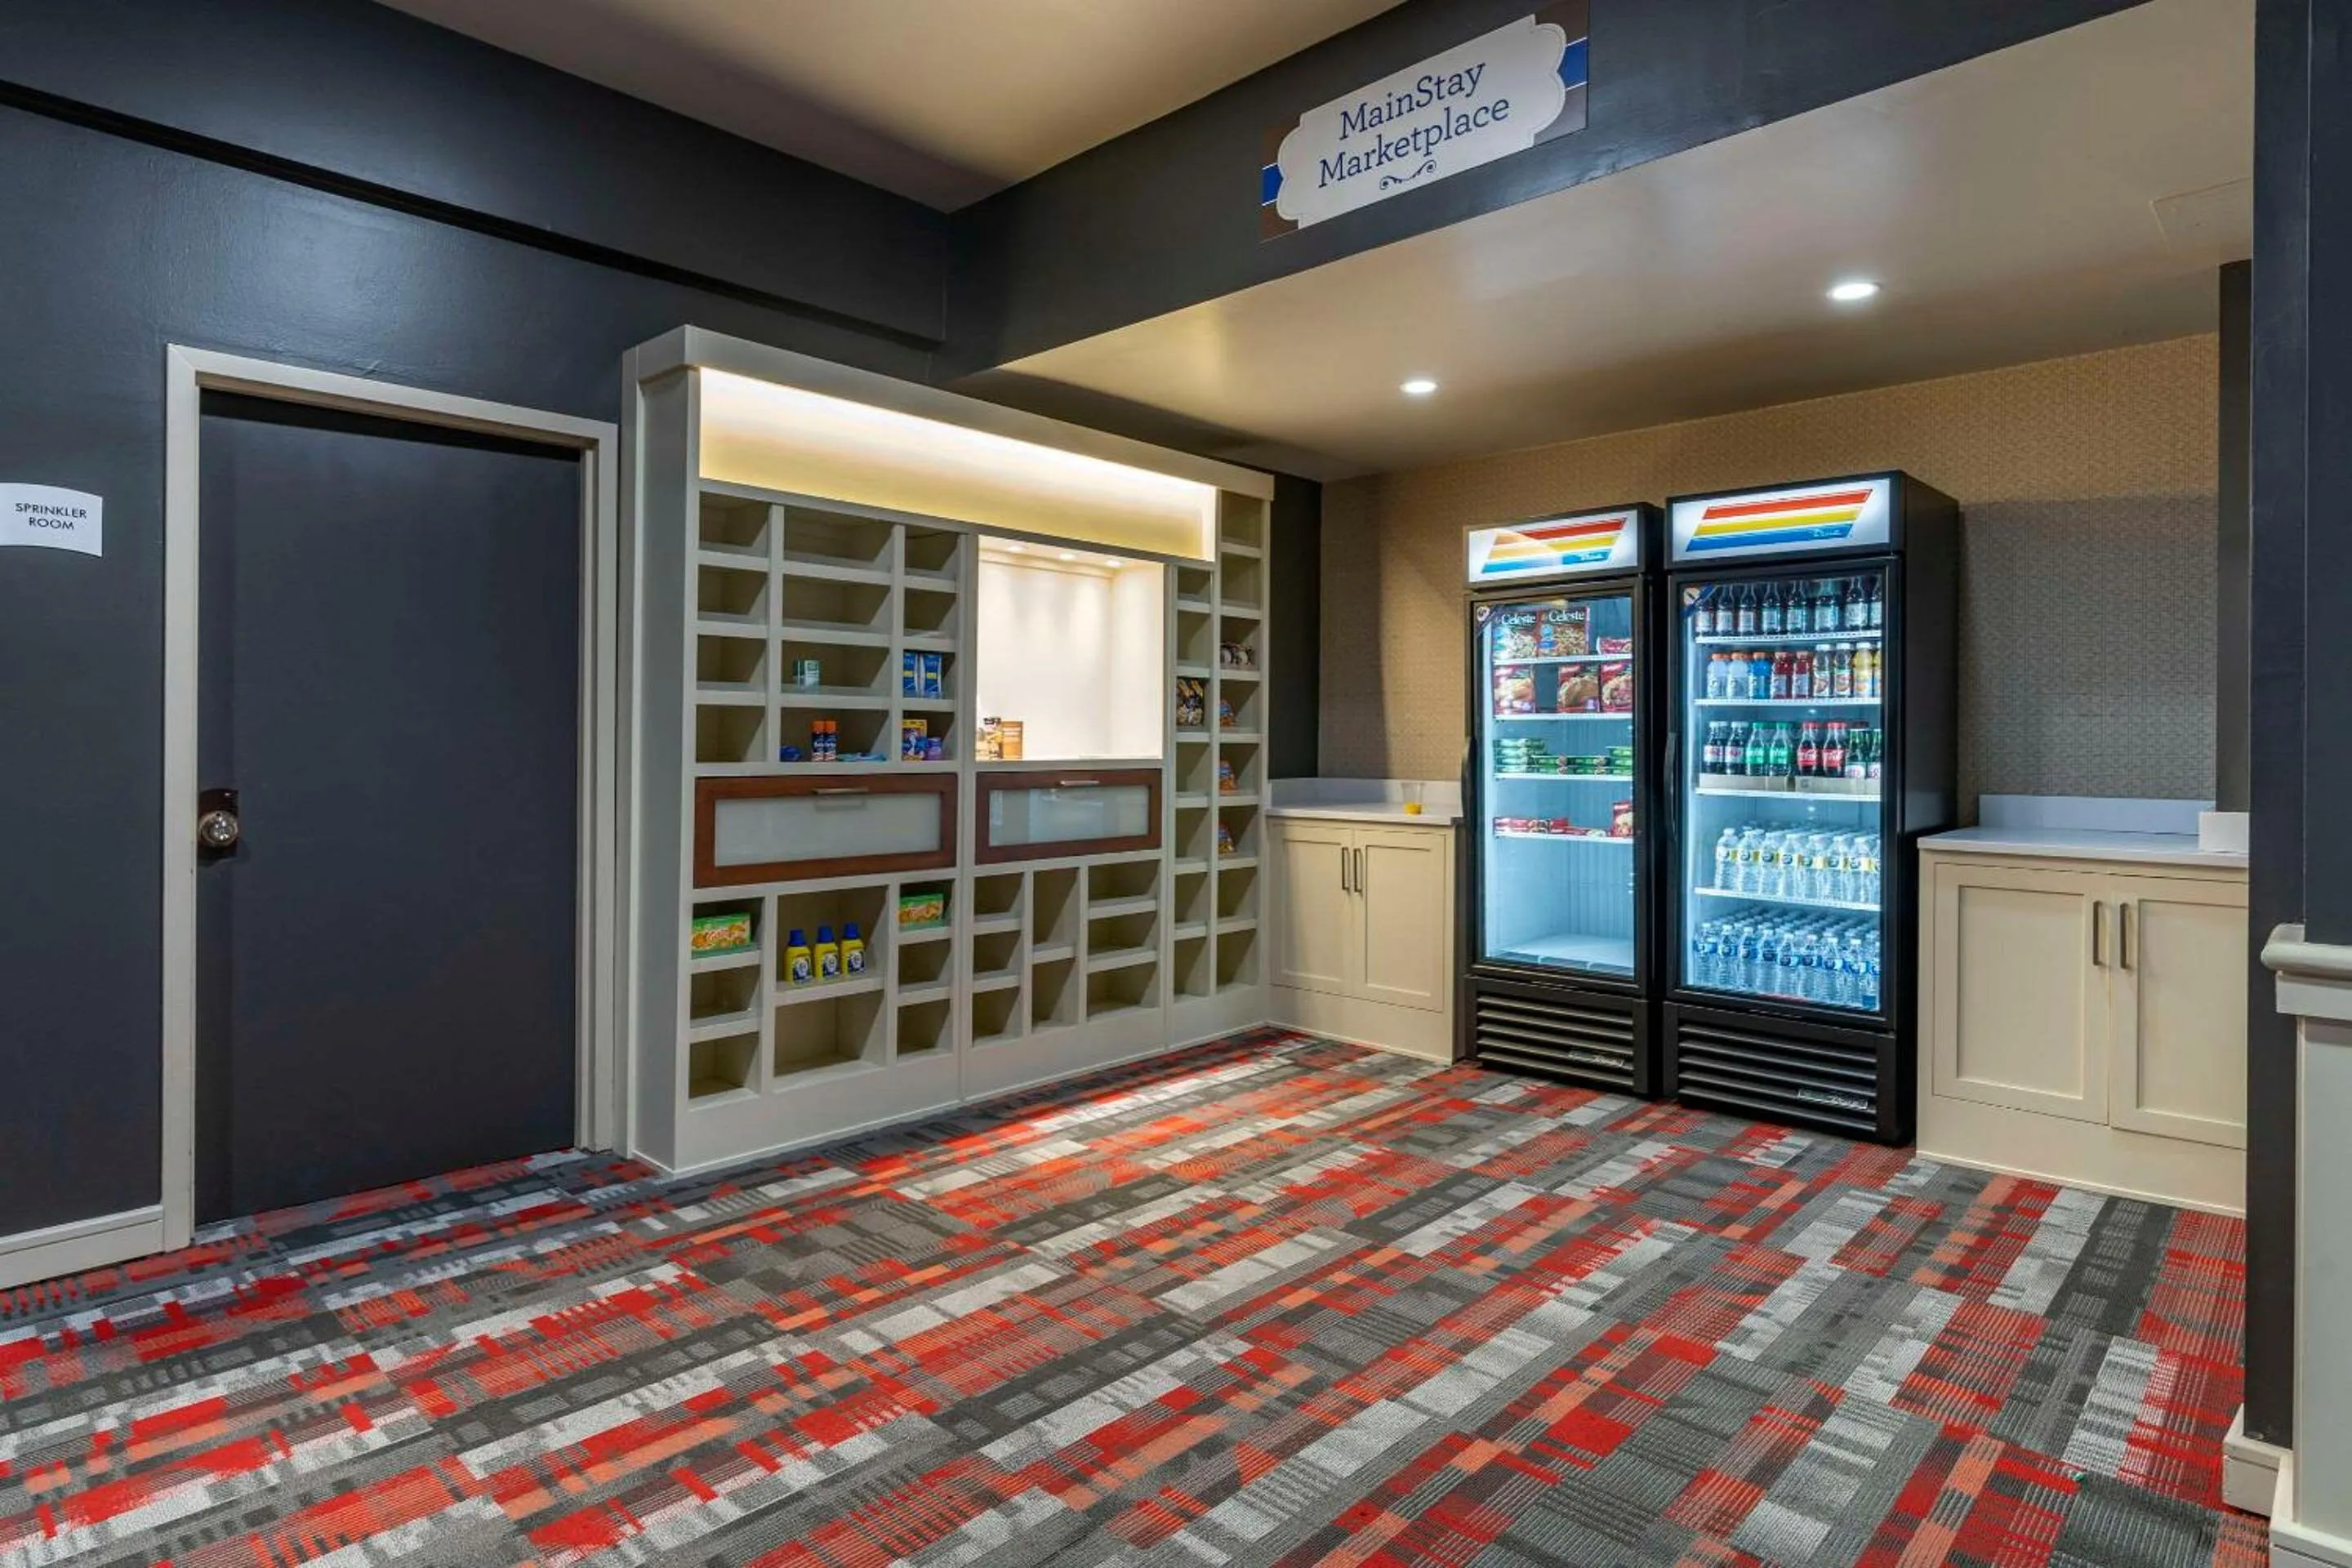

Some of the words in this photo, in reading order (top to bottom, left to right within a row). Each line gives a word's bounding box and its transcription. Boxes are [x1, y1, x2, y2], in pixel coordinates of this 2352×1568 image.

[1339, 62, 1486, 140] MainStay
[1317, 96, 1510, 188] Marketplace
[15, 502, 87, 519] SPRINKLER
[29, 517, 74, 530] ROOM
[1501, 612, 1535, 624] Celeste
[1548, 610, 1584, 621] Celeste
